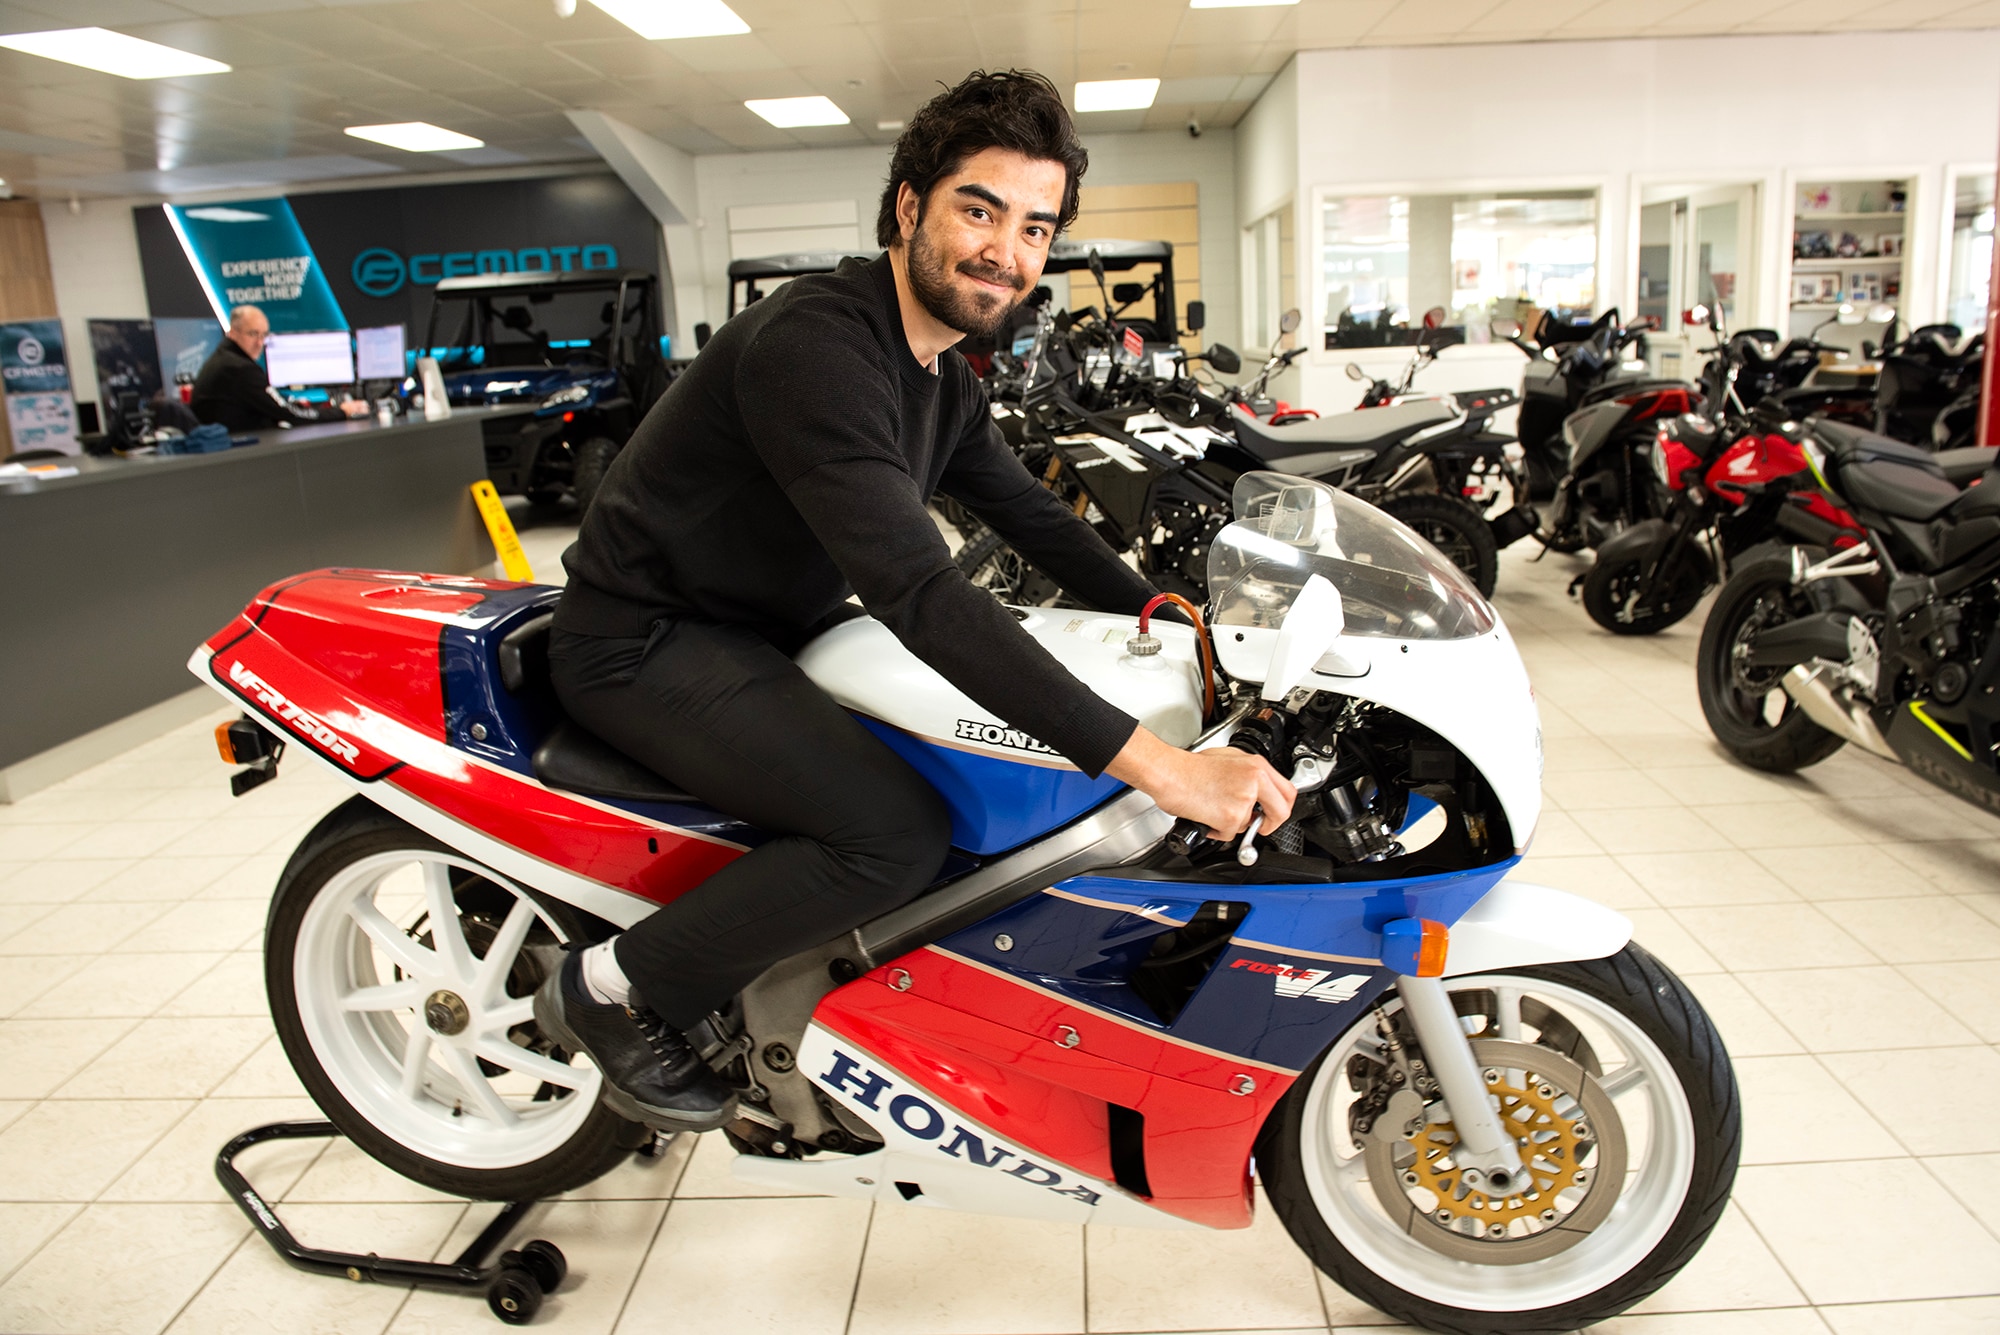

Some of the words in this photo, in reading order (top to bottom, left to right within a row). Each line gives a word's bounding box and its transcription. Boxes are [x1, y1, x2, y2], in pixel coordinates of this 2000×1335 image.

[408, 244, 618, 284] CFMOTO
[229, 660, 361, 765] VFR750R
[1229, 958, 1321, 981] FORCE
[1274, 963, 1373, 1004] V4
[819, 1049, 1102, 1208] HONDA
